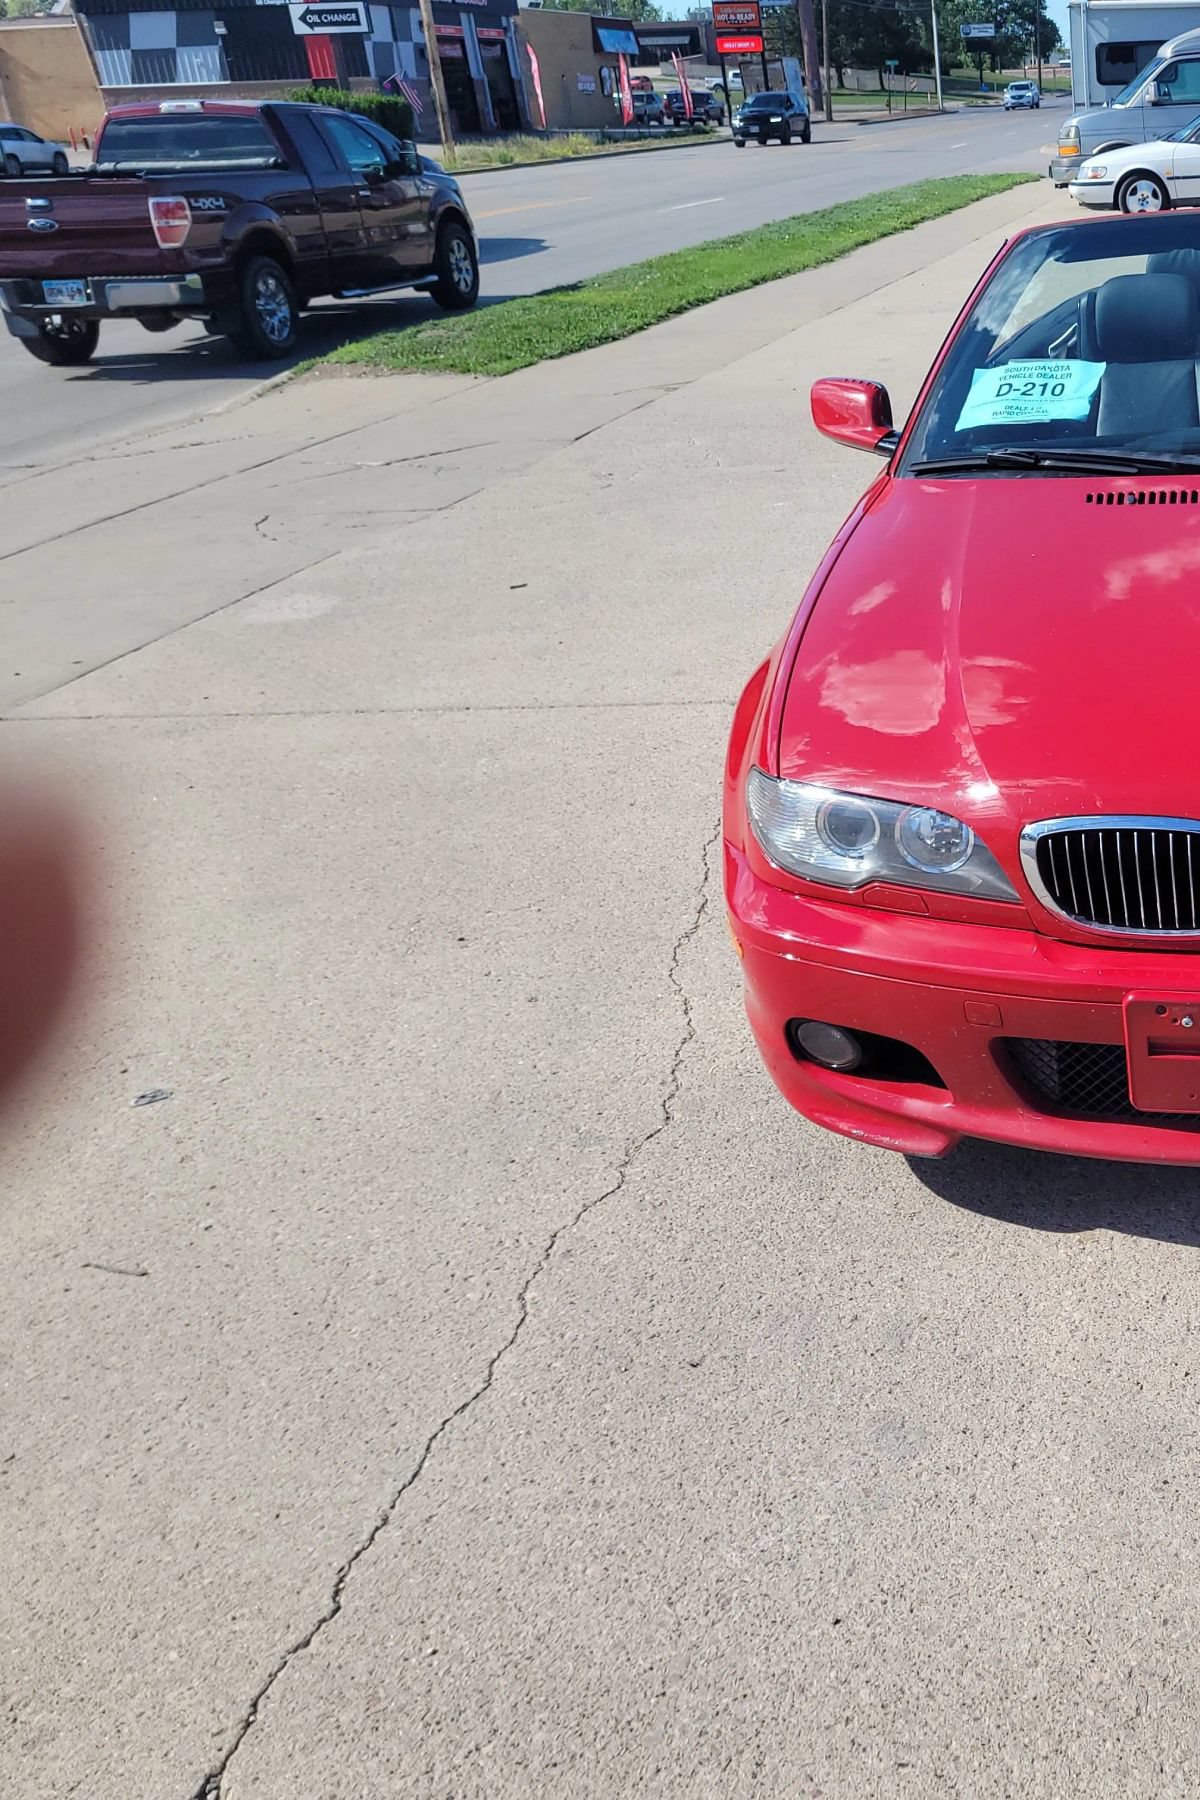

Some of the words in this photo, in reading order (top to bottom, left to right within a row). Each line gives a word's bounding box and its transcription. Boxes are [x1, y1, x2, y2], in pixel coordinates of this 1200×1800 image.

[306, 14, 321, 23] OIL
[321, 13, 358, 22] CHANGE
[1004, 366, 1033, 374] SOUTH
[1034, 364, 1071, 373] DAKOTA
[999, 372, 1034, 381] VEHICLE
[1036, 372, 1072, 380] DEALER
[995, 382, 1065, 397] D-210
